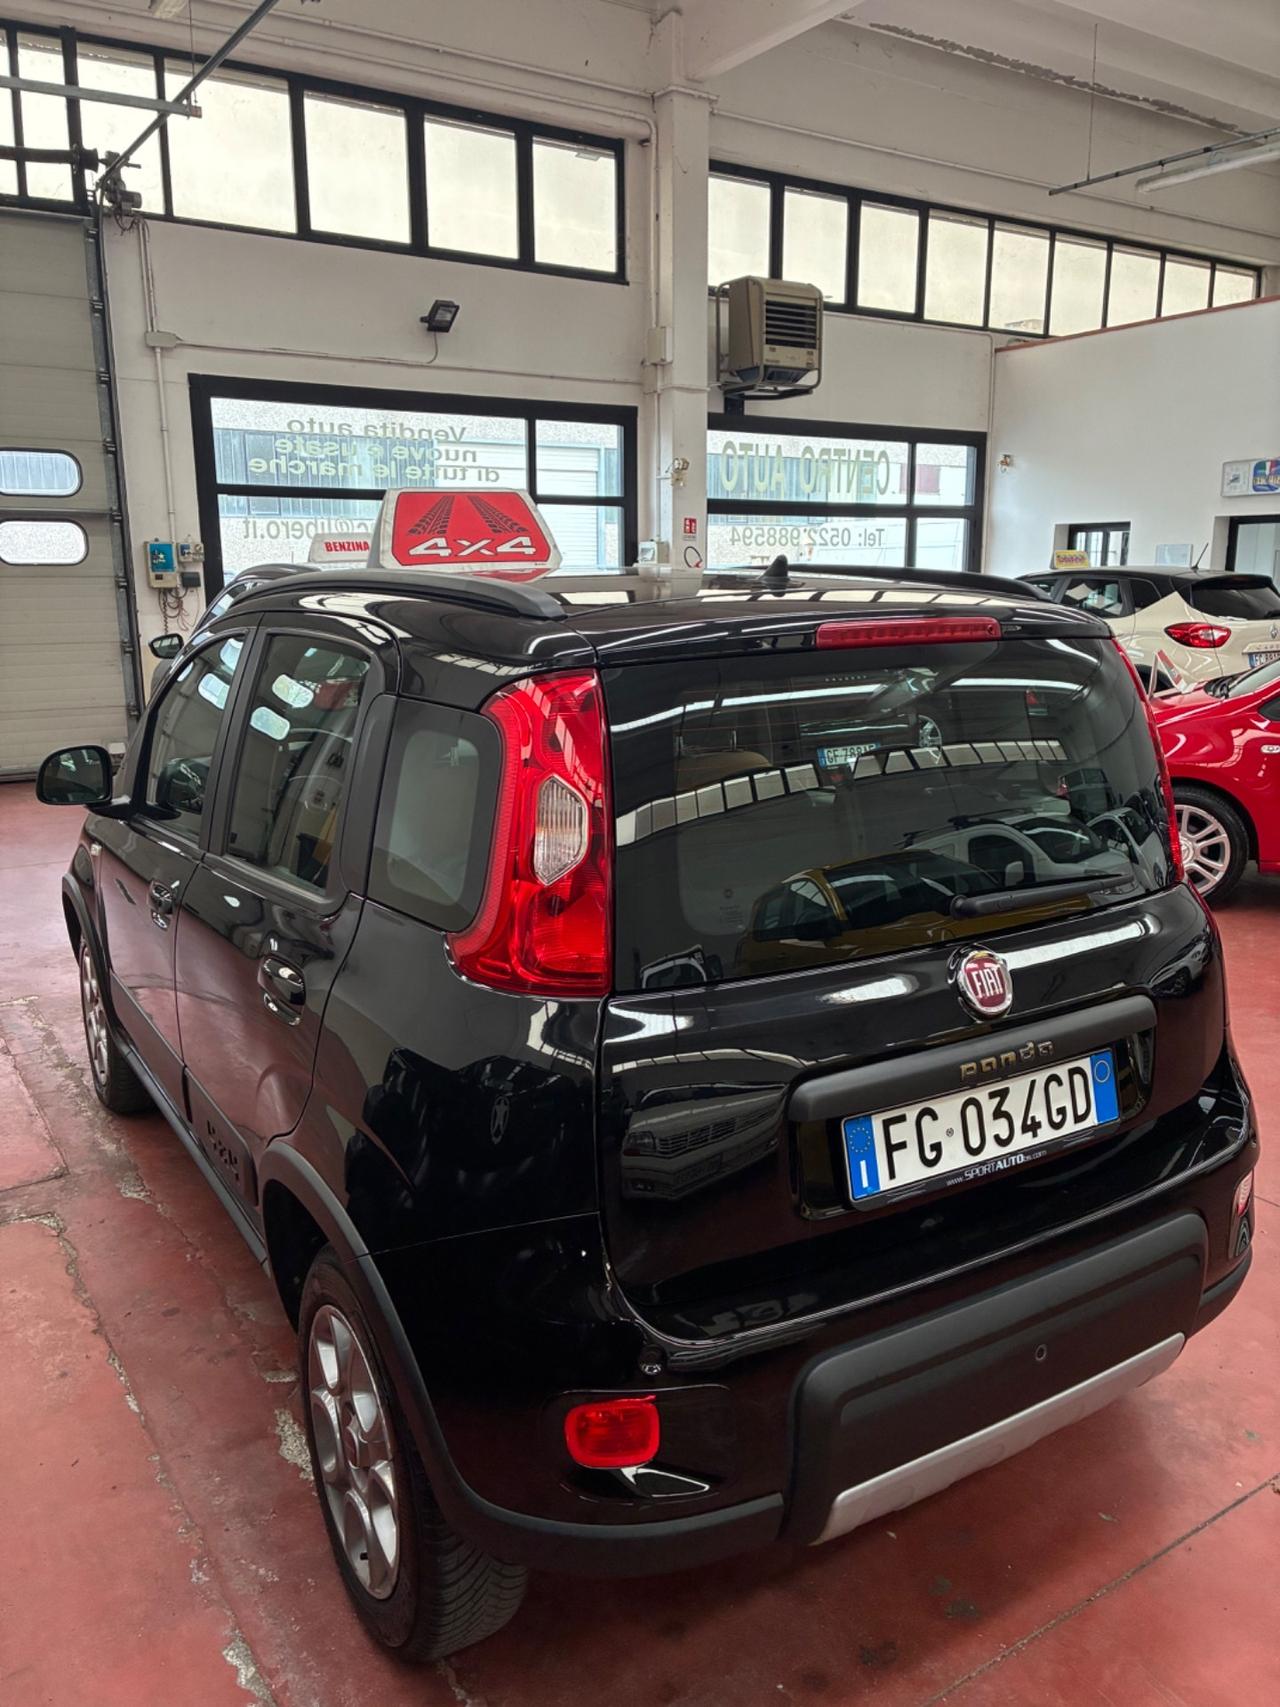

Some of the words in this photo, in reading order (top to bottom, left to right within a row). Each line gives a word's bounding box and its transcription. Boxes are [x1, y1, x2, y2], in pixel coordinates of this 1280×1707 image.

[324, 541, 370, 552] BENZINA
[972, 967, 1004, 999] FIAT
[960, 1041, 1053, 1080] panda
